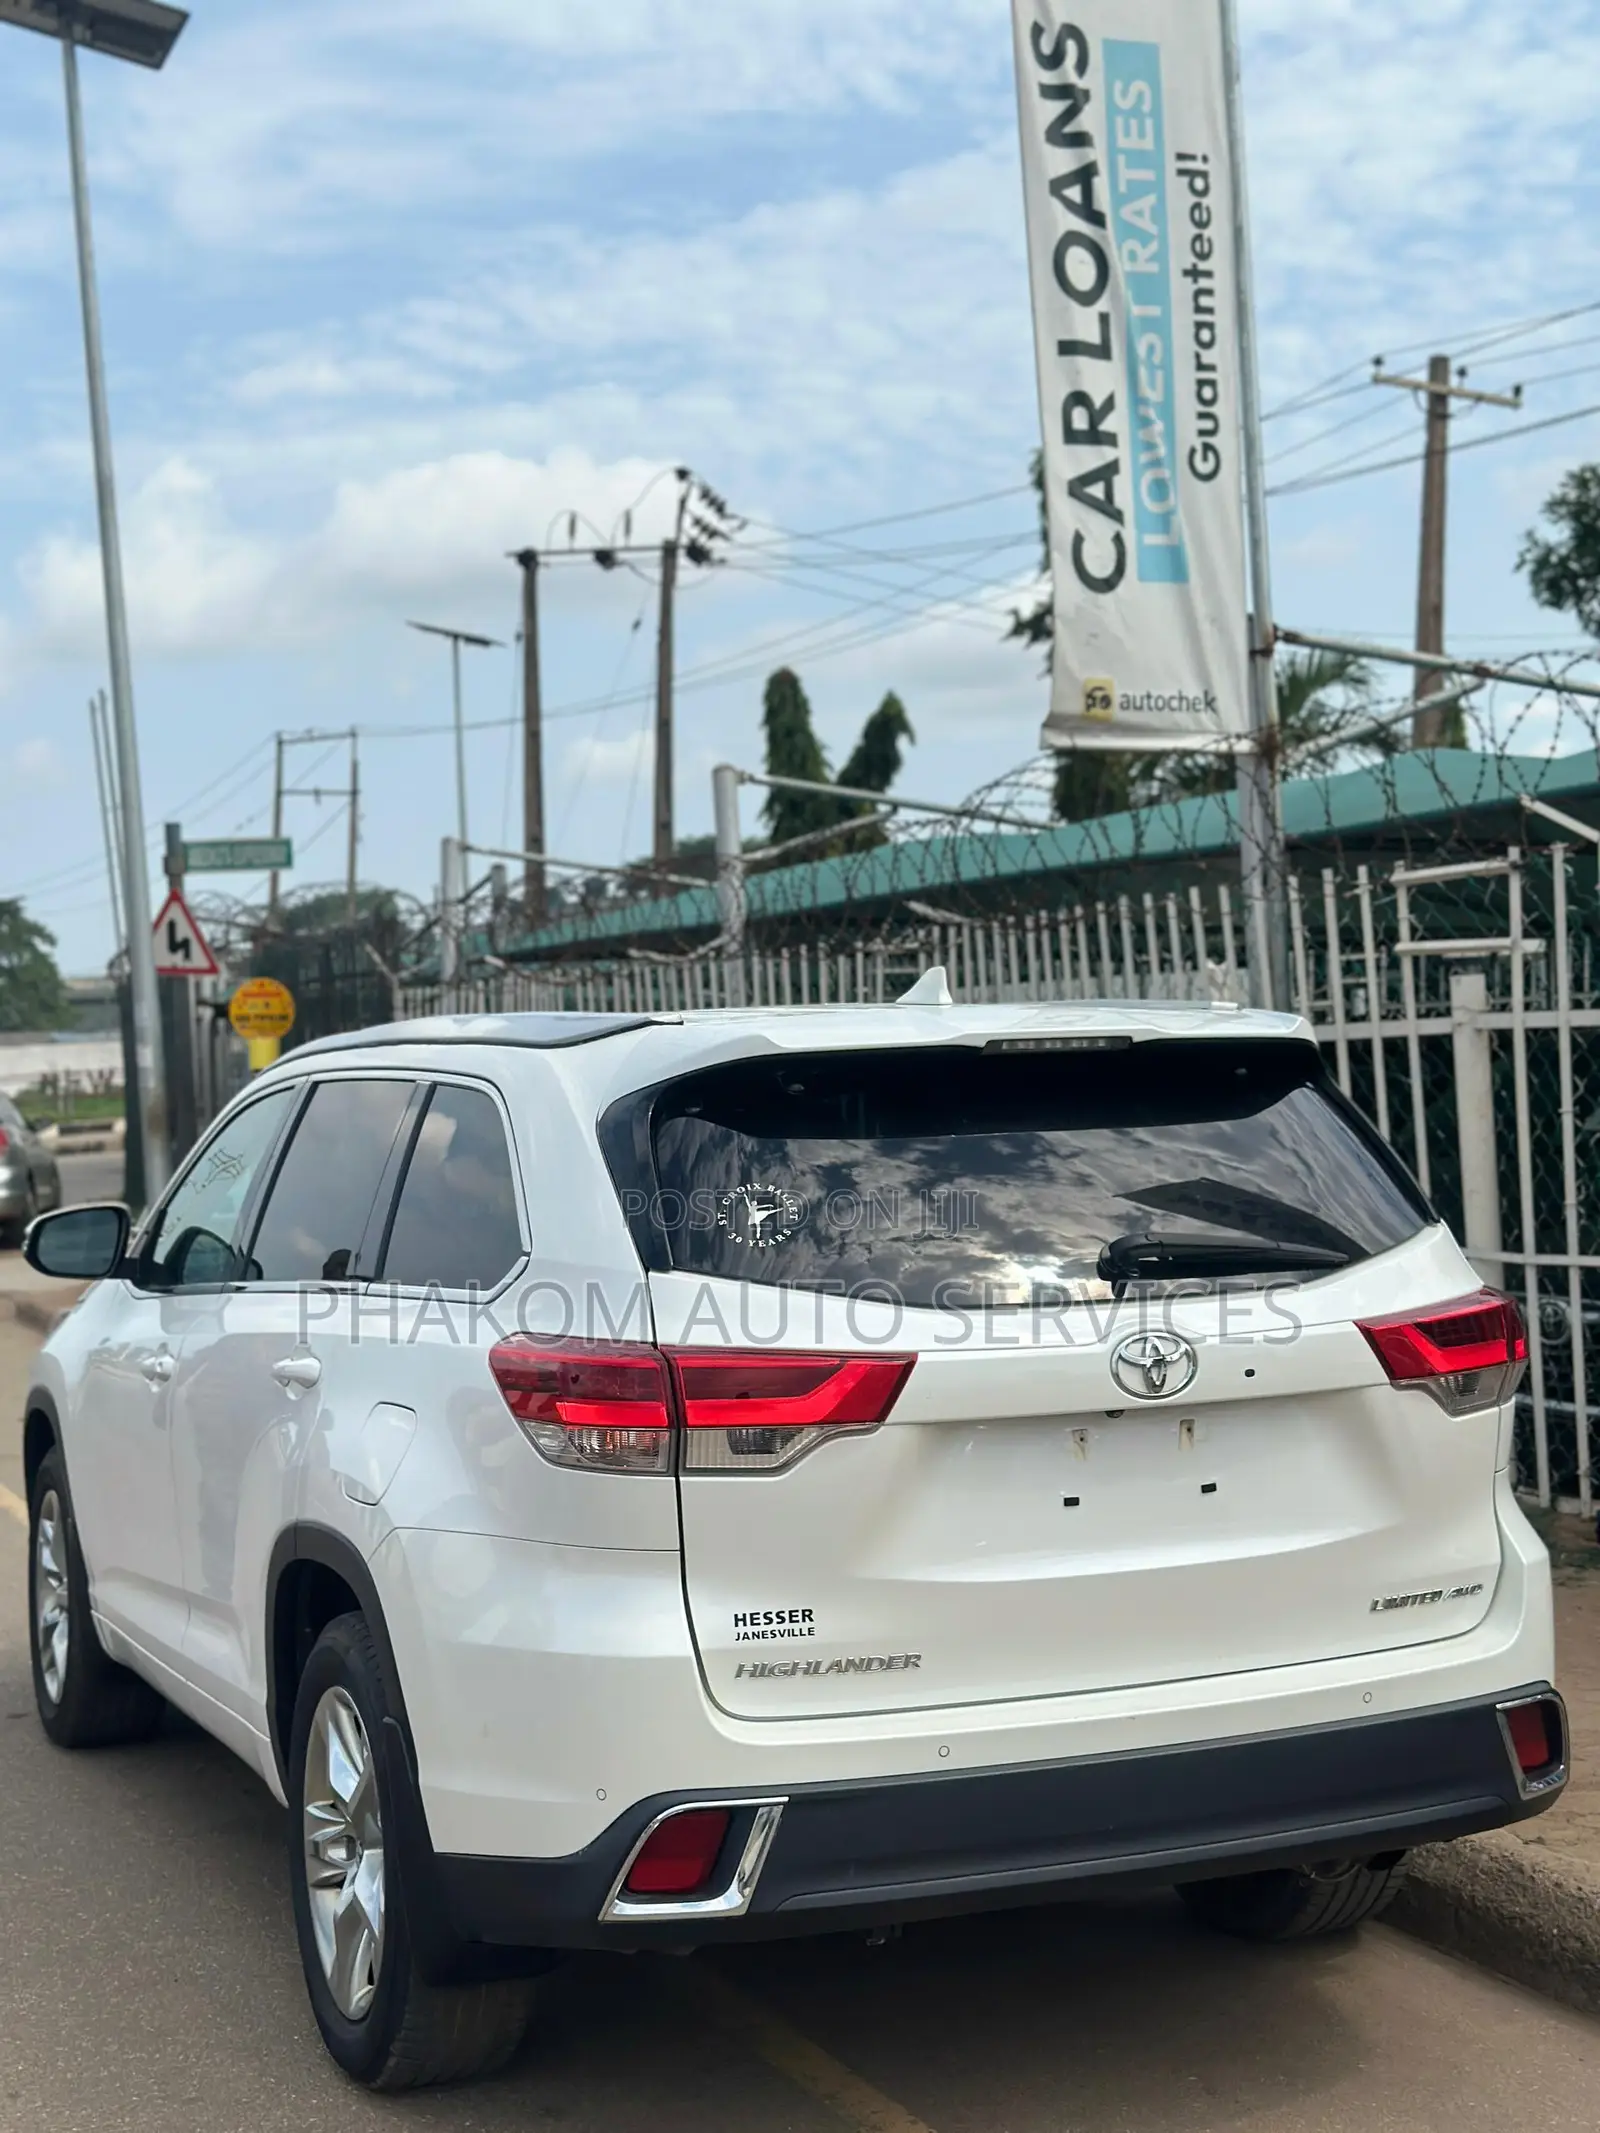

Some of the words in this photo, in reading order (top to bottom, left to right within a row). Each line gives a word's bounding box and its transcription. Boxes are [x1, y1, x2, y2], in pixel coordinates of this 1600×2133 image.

[1113, 79, 1161, 271] RATES
[1030, 20, 1112, 362] LOANS
[1174, 151, 1222, 483] Guaranteed!
[1129, 301, 1183, 548] LOWEST
[1063, 389, 1126, 594] CAR
[1119, 689, 1217, 713] autochek
[722, 1183, 762, 1206] CROIX
[767, 1184, 799, 1221] BALLET
[717, 1209, 728, 1226] ST.
[728, 1232, 743, 1243] 30
[748, 1228, 792, 1247] YEARS
[1370, 1589, 1443, 1612] LIMITED
[734, 1608, 814, 1628] HESSER
[735, 1626, 816, 1641] JANESVILLE
[734, 1652, 923, 1680] HIGHLANDER
